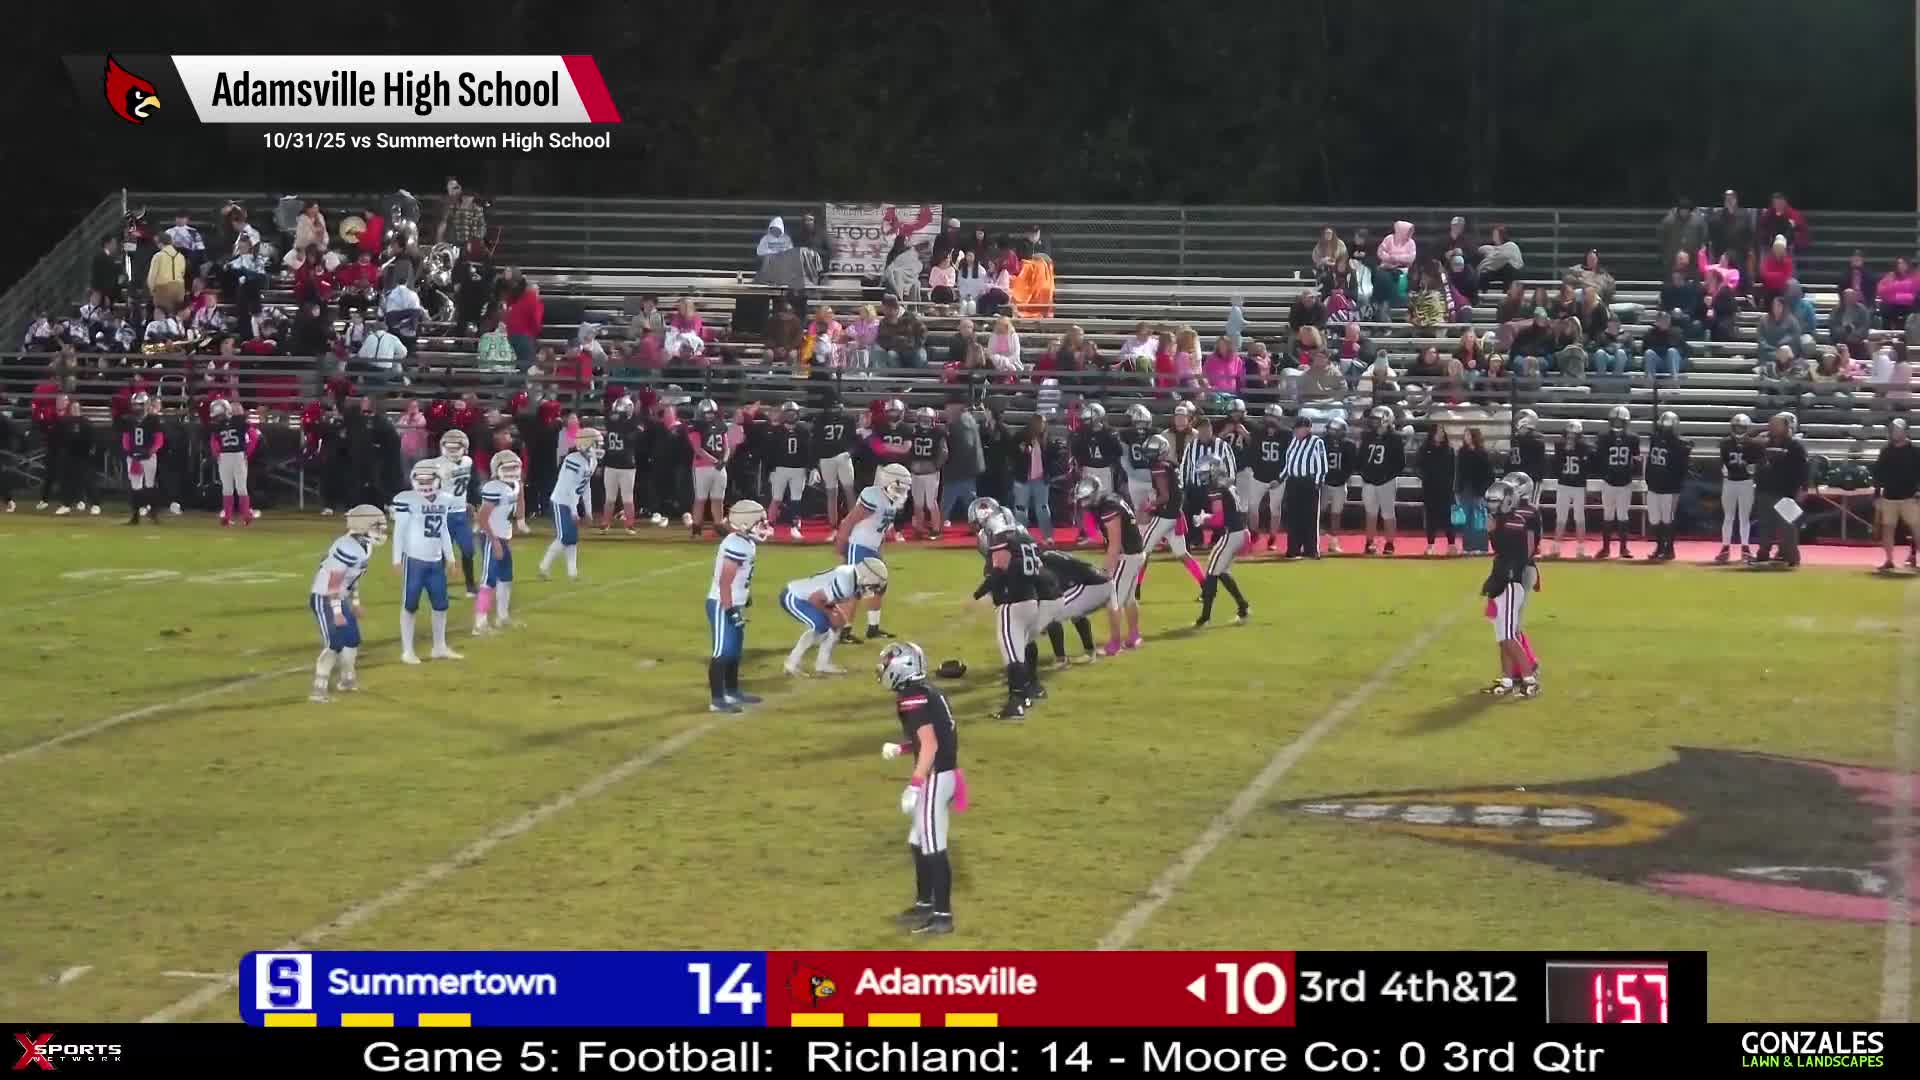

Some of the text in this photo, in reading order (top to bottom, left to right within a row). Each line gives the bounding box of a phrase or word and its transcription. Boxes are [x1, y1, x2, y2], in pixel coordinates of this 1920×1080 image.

[134, 427, 144, 446] 8
[220, 428, 240, 447] 25
[824, 424, 845, 441] 37
[706, 434, 724, 451] 42
[913, 438, 934, 456] 62
[1261, 441, 1280, 462] 56
[1367, 444, 1385, 465] 73
[423, 515, 443, 538] 52
